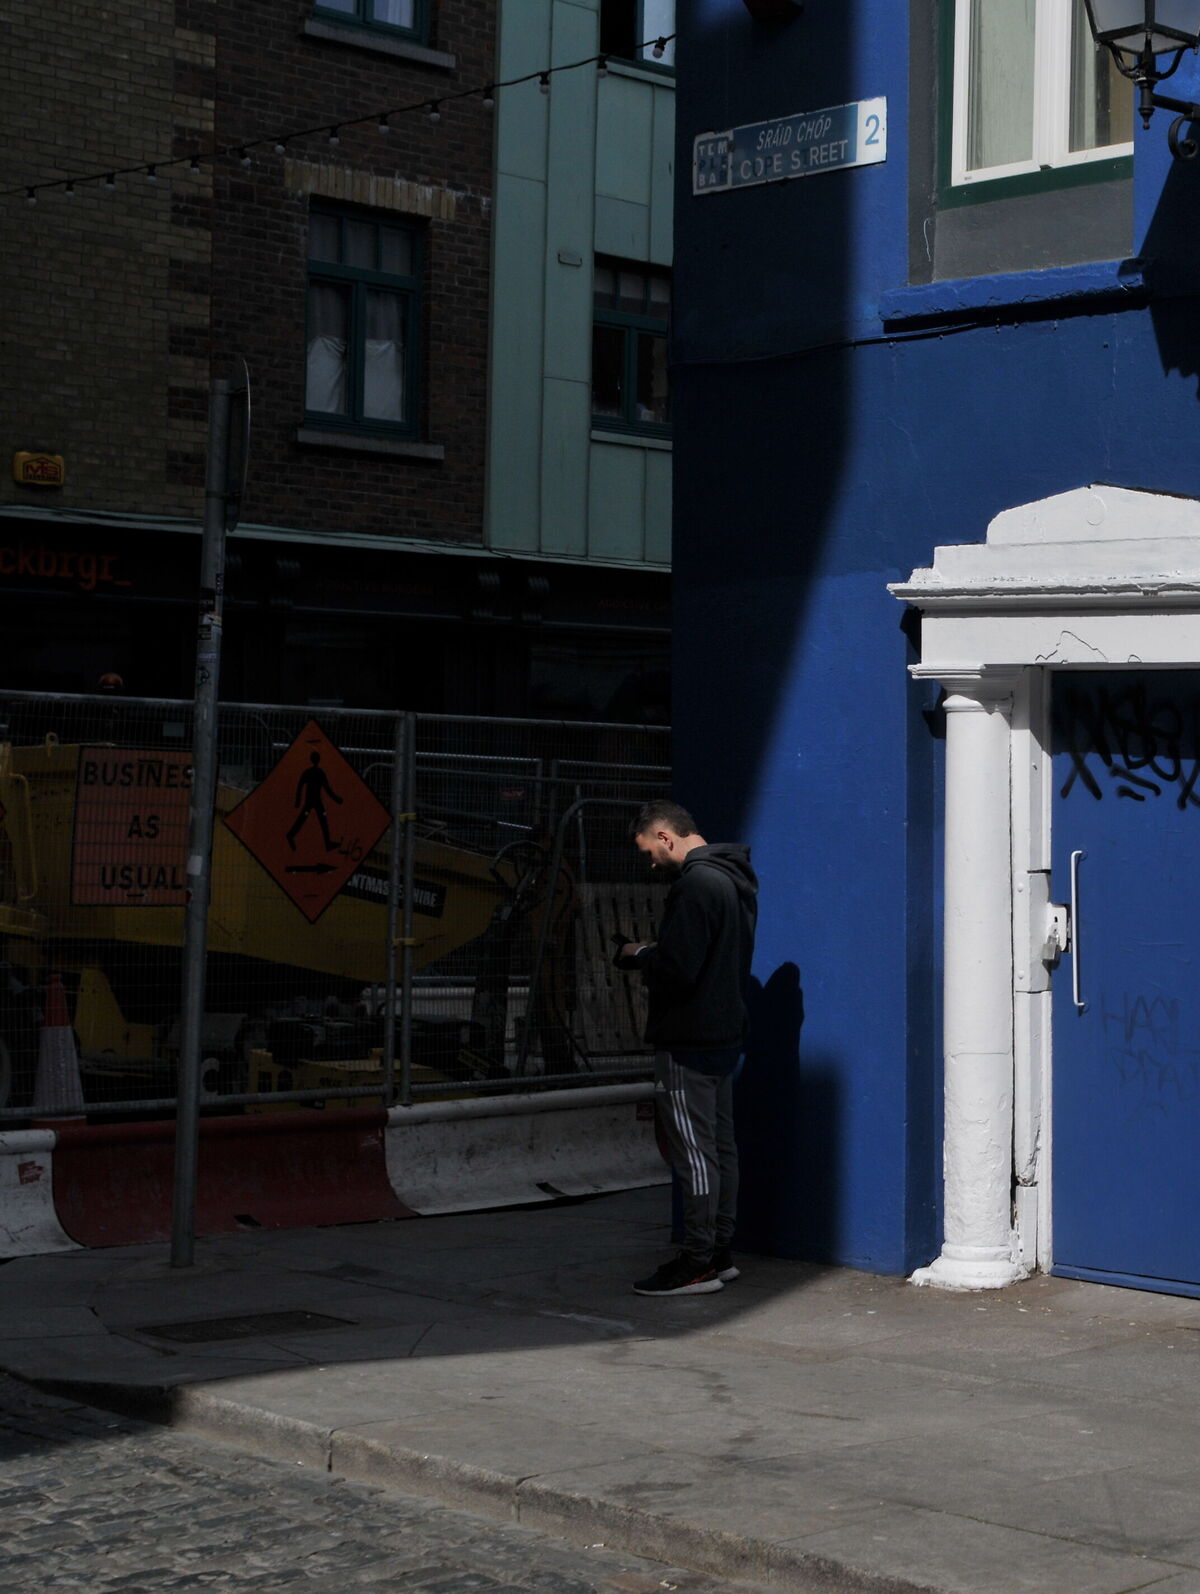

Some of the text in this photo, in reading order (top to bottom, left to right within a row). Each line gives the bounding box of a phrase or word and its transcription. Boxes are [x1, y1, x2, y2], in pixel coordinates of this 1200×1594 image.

[797, 114, 832, 143] CHÓP
[865, 114, 880, 145] 2
[84, 761, 193, 788] BUSINES
[128, 815, 160, 838] AS
[102, 866, 182, 890] USUAL
